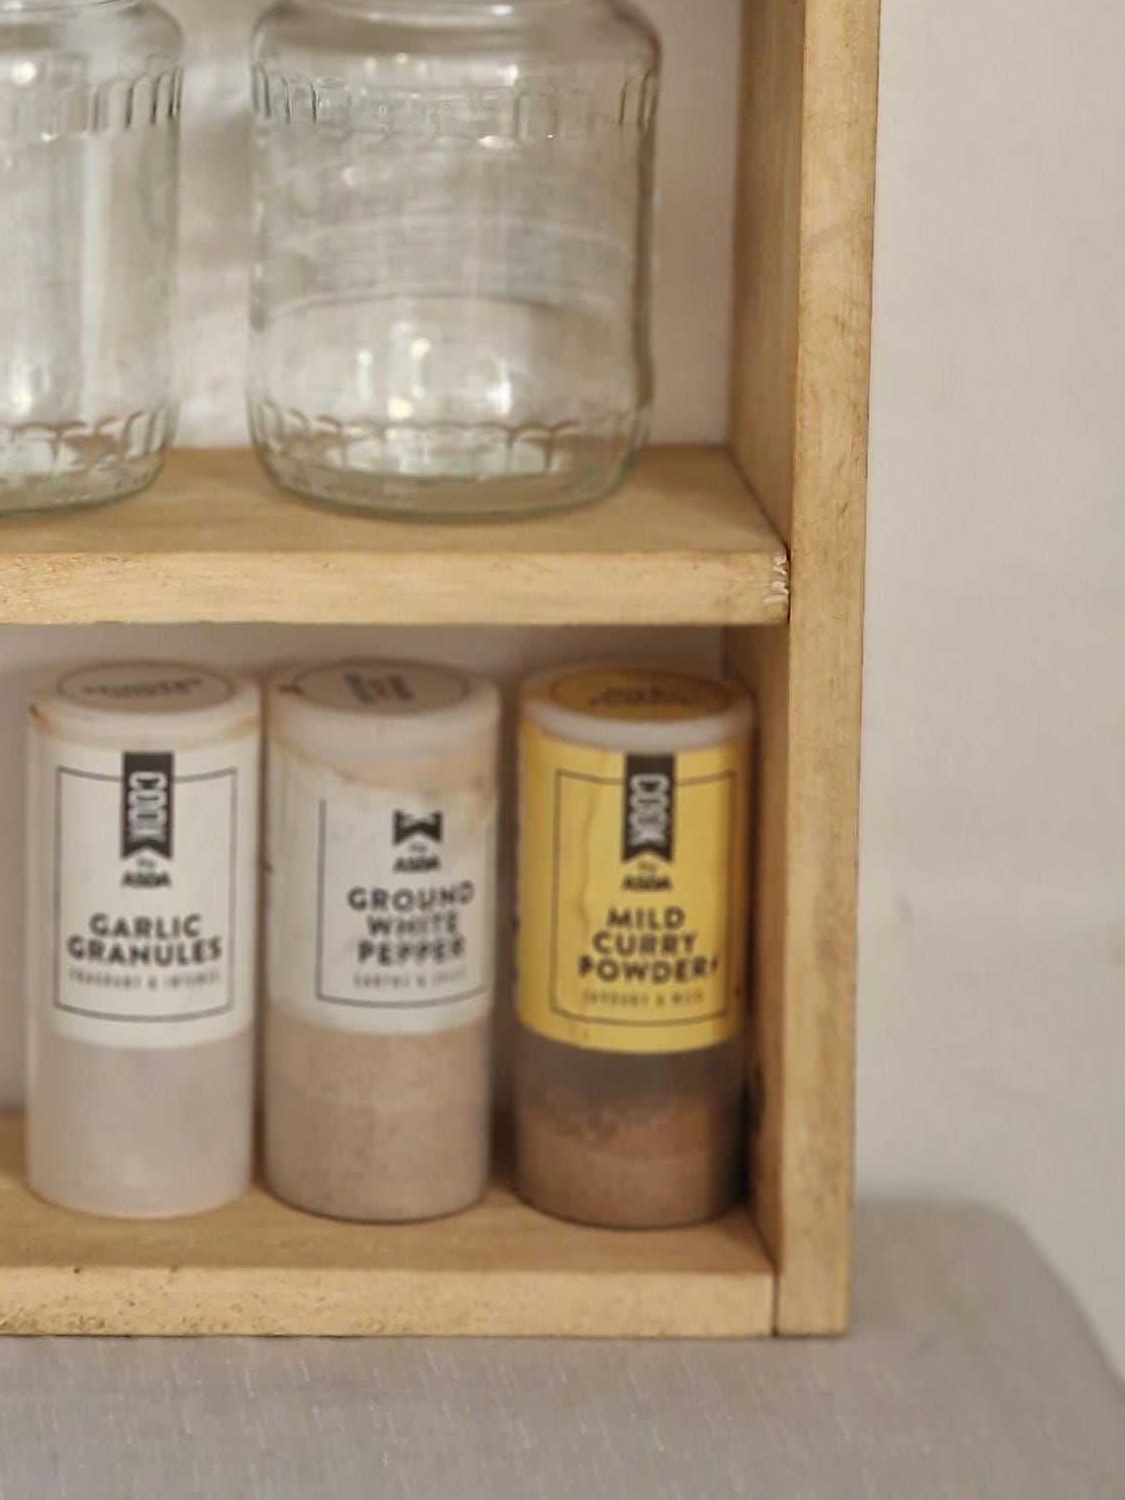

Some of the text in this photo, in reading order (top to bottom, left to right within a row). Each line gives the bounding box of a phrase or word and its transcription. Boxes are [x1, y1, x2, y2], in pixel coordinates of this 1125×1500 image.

[347, 880, 475, 913] GROUND
[89, 913, 203, 941] GARLIC
[366, 911, 458, 936] WHITE
[606, 906, 686, 932] MILD
[66, 934, 223, 967] GRANULES
[357, 934, 467, 967] PEPPER
[592, 930, 698, 958] CURRY
